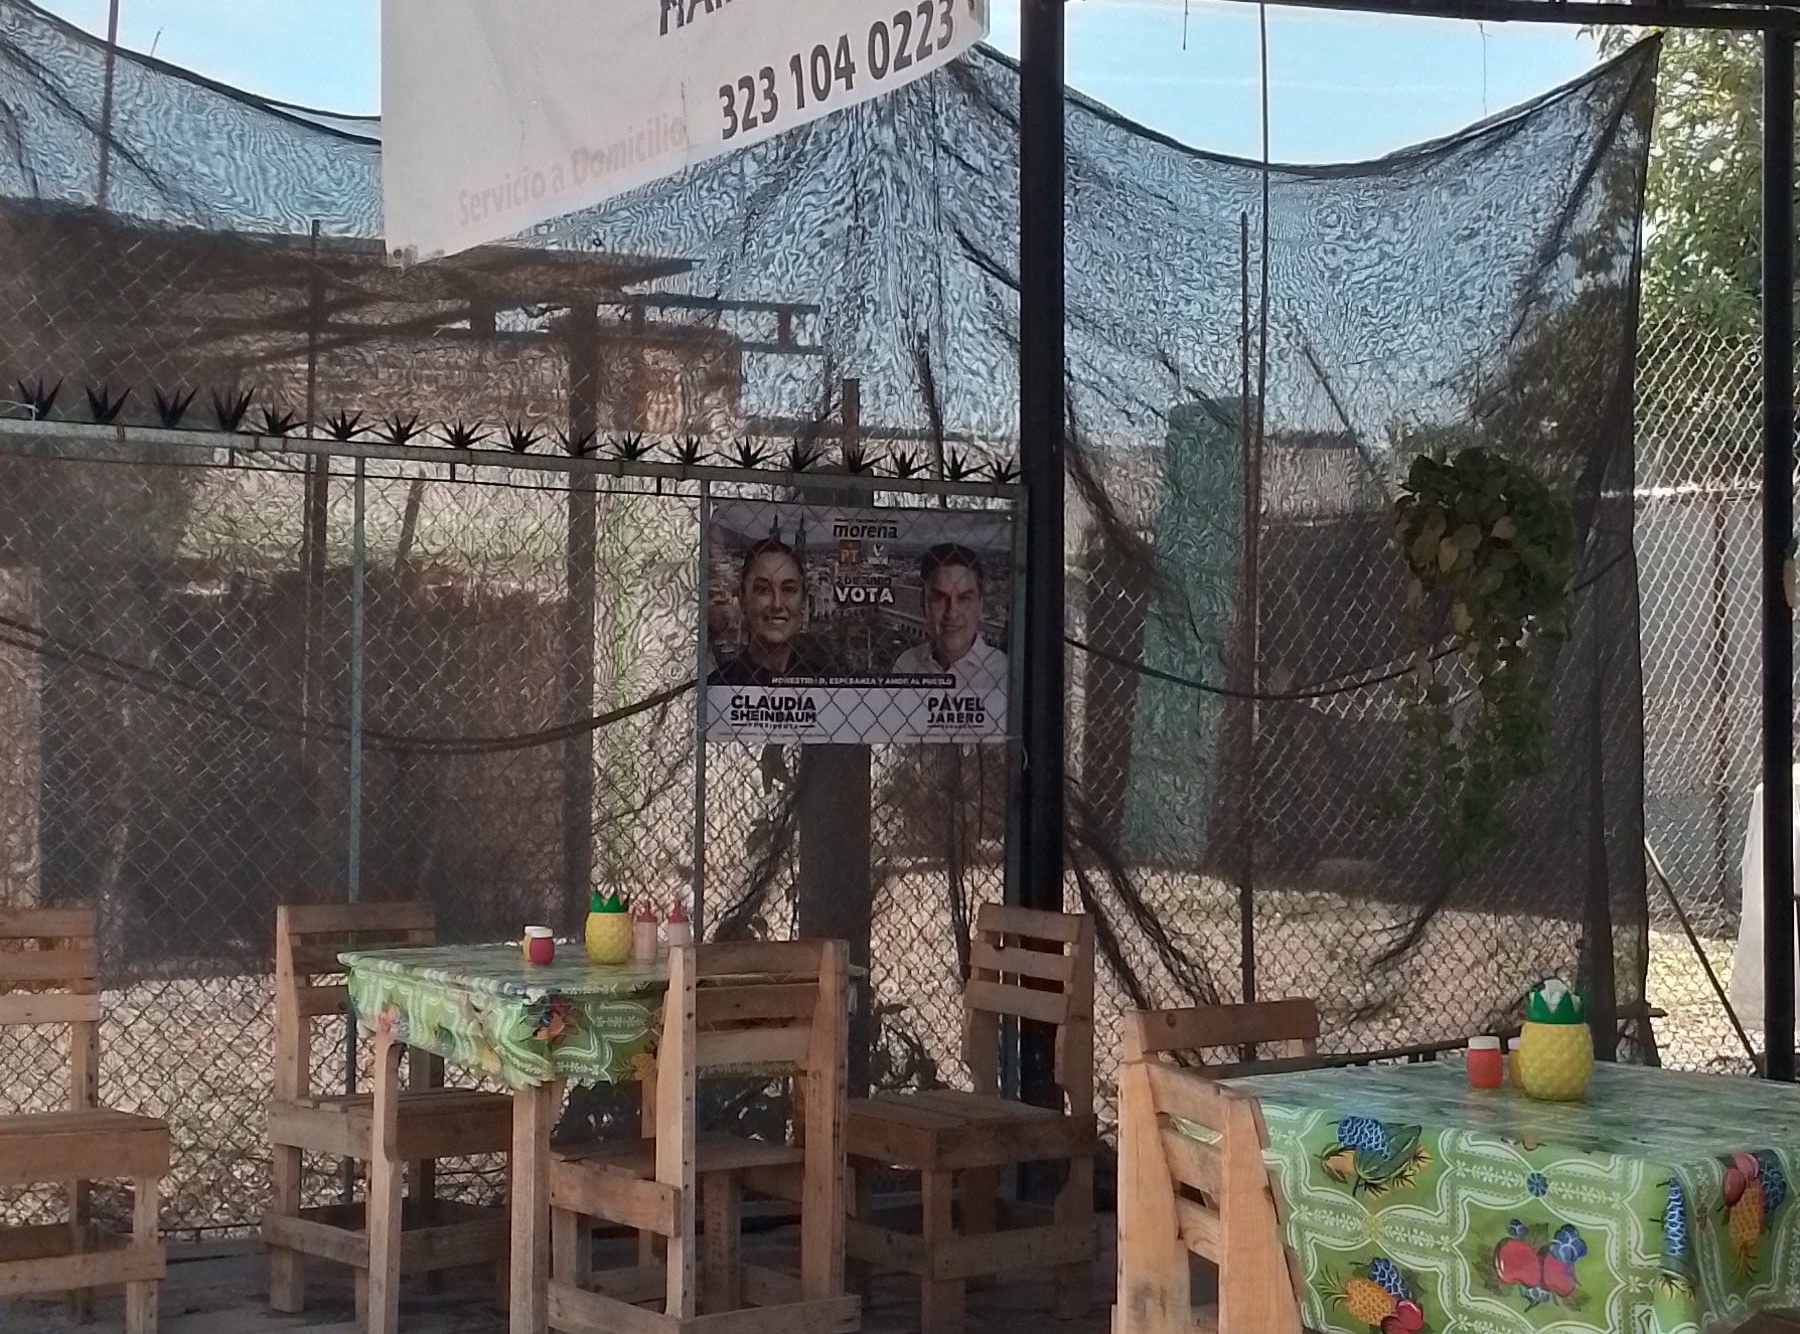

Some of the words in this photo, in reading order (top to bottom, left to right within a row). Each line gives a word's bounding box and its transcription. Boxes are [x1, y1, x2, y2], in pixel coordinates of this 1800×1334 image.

[719, 66, 778, 140] 323
[790, 35, 855, 111] 104
[459, 166, 546, 226] Servicio
[552, 163, 565, 194] a
[571, 113, 685, 186] Domicilio
[833, 524, 897, 538] morena
[841, 549, 859, 562] PT
[834, 587, 895, 603] VOTA
[730, 695, 817, 711] CLAUDIA
[730, 710, 817, 723] SHEINBAUM
[927, 712, 985, 724] JARERO
